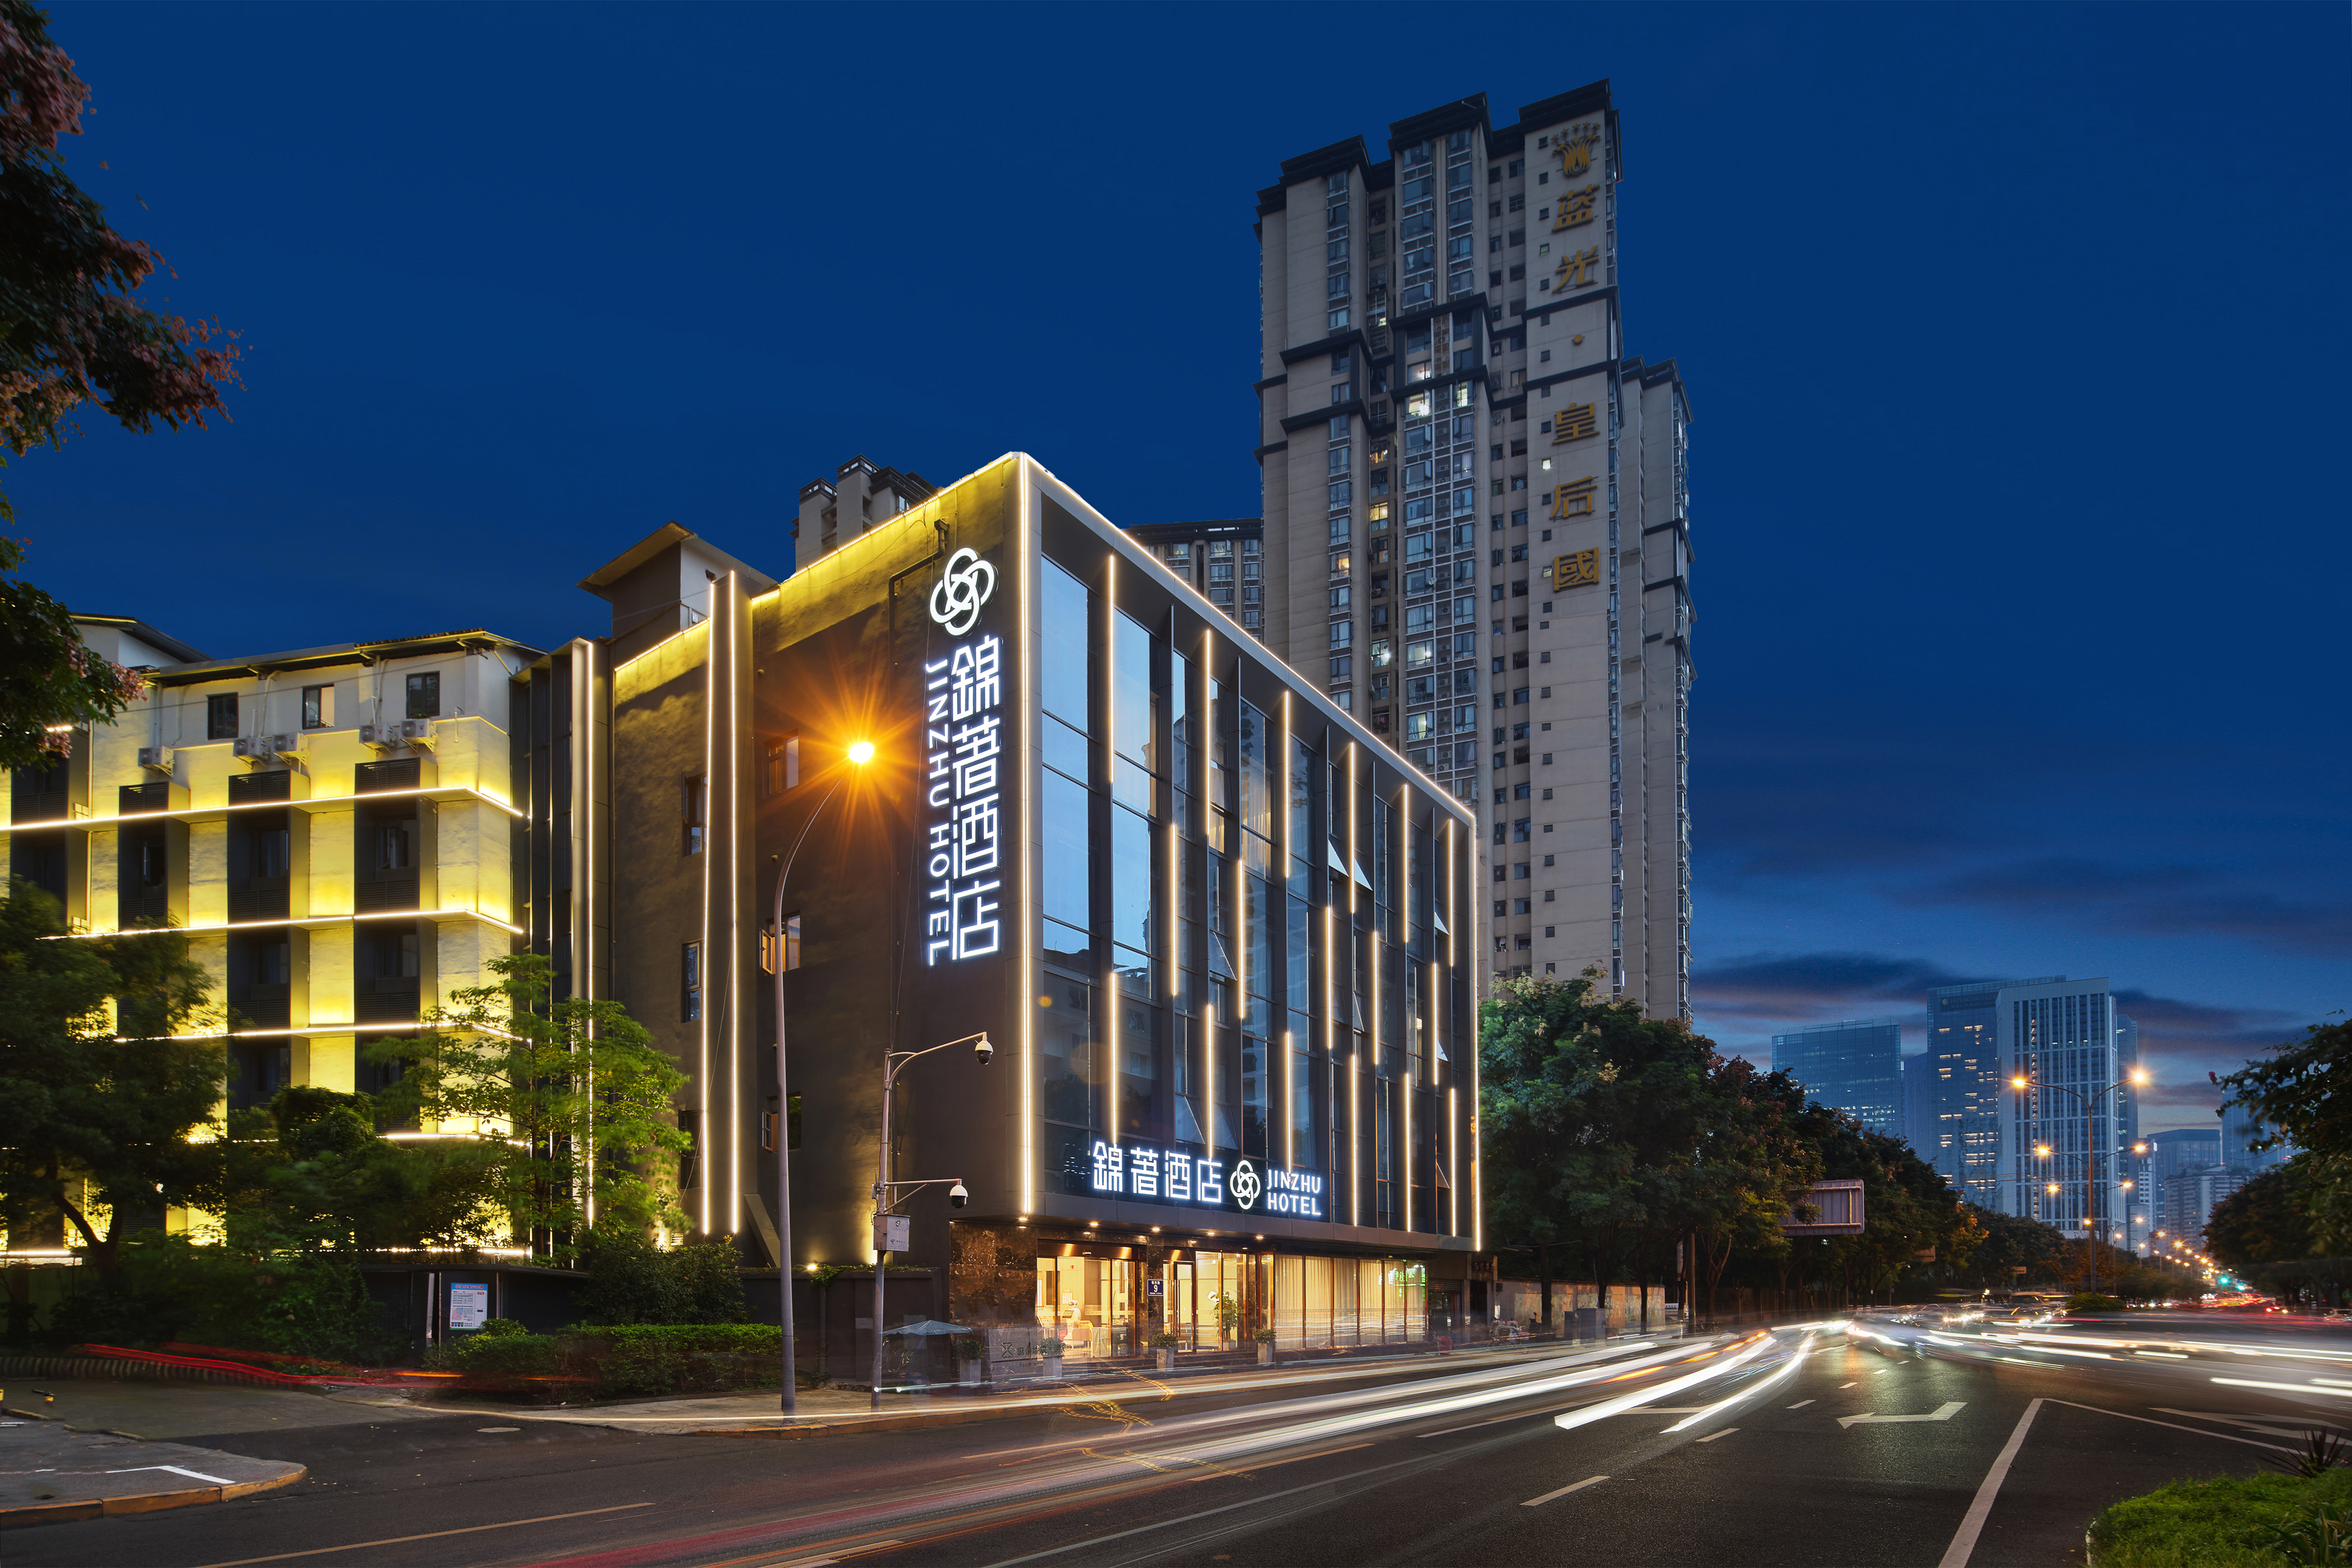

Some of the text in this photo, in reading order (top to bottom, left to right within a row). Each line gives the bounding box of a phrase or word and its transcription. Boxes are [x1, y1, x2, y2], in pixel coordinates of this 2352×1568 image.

[925, 658, 950, 966] JINZHU HOTEL
[1266, 1169, 1321, 1194] JINZHU
[1267, 1192, 1321, 1216] HOTEL
[1153, 1284, 1158, 1293] 9
